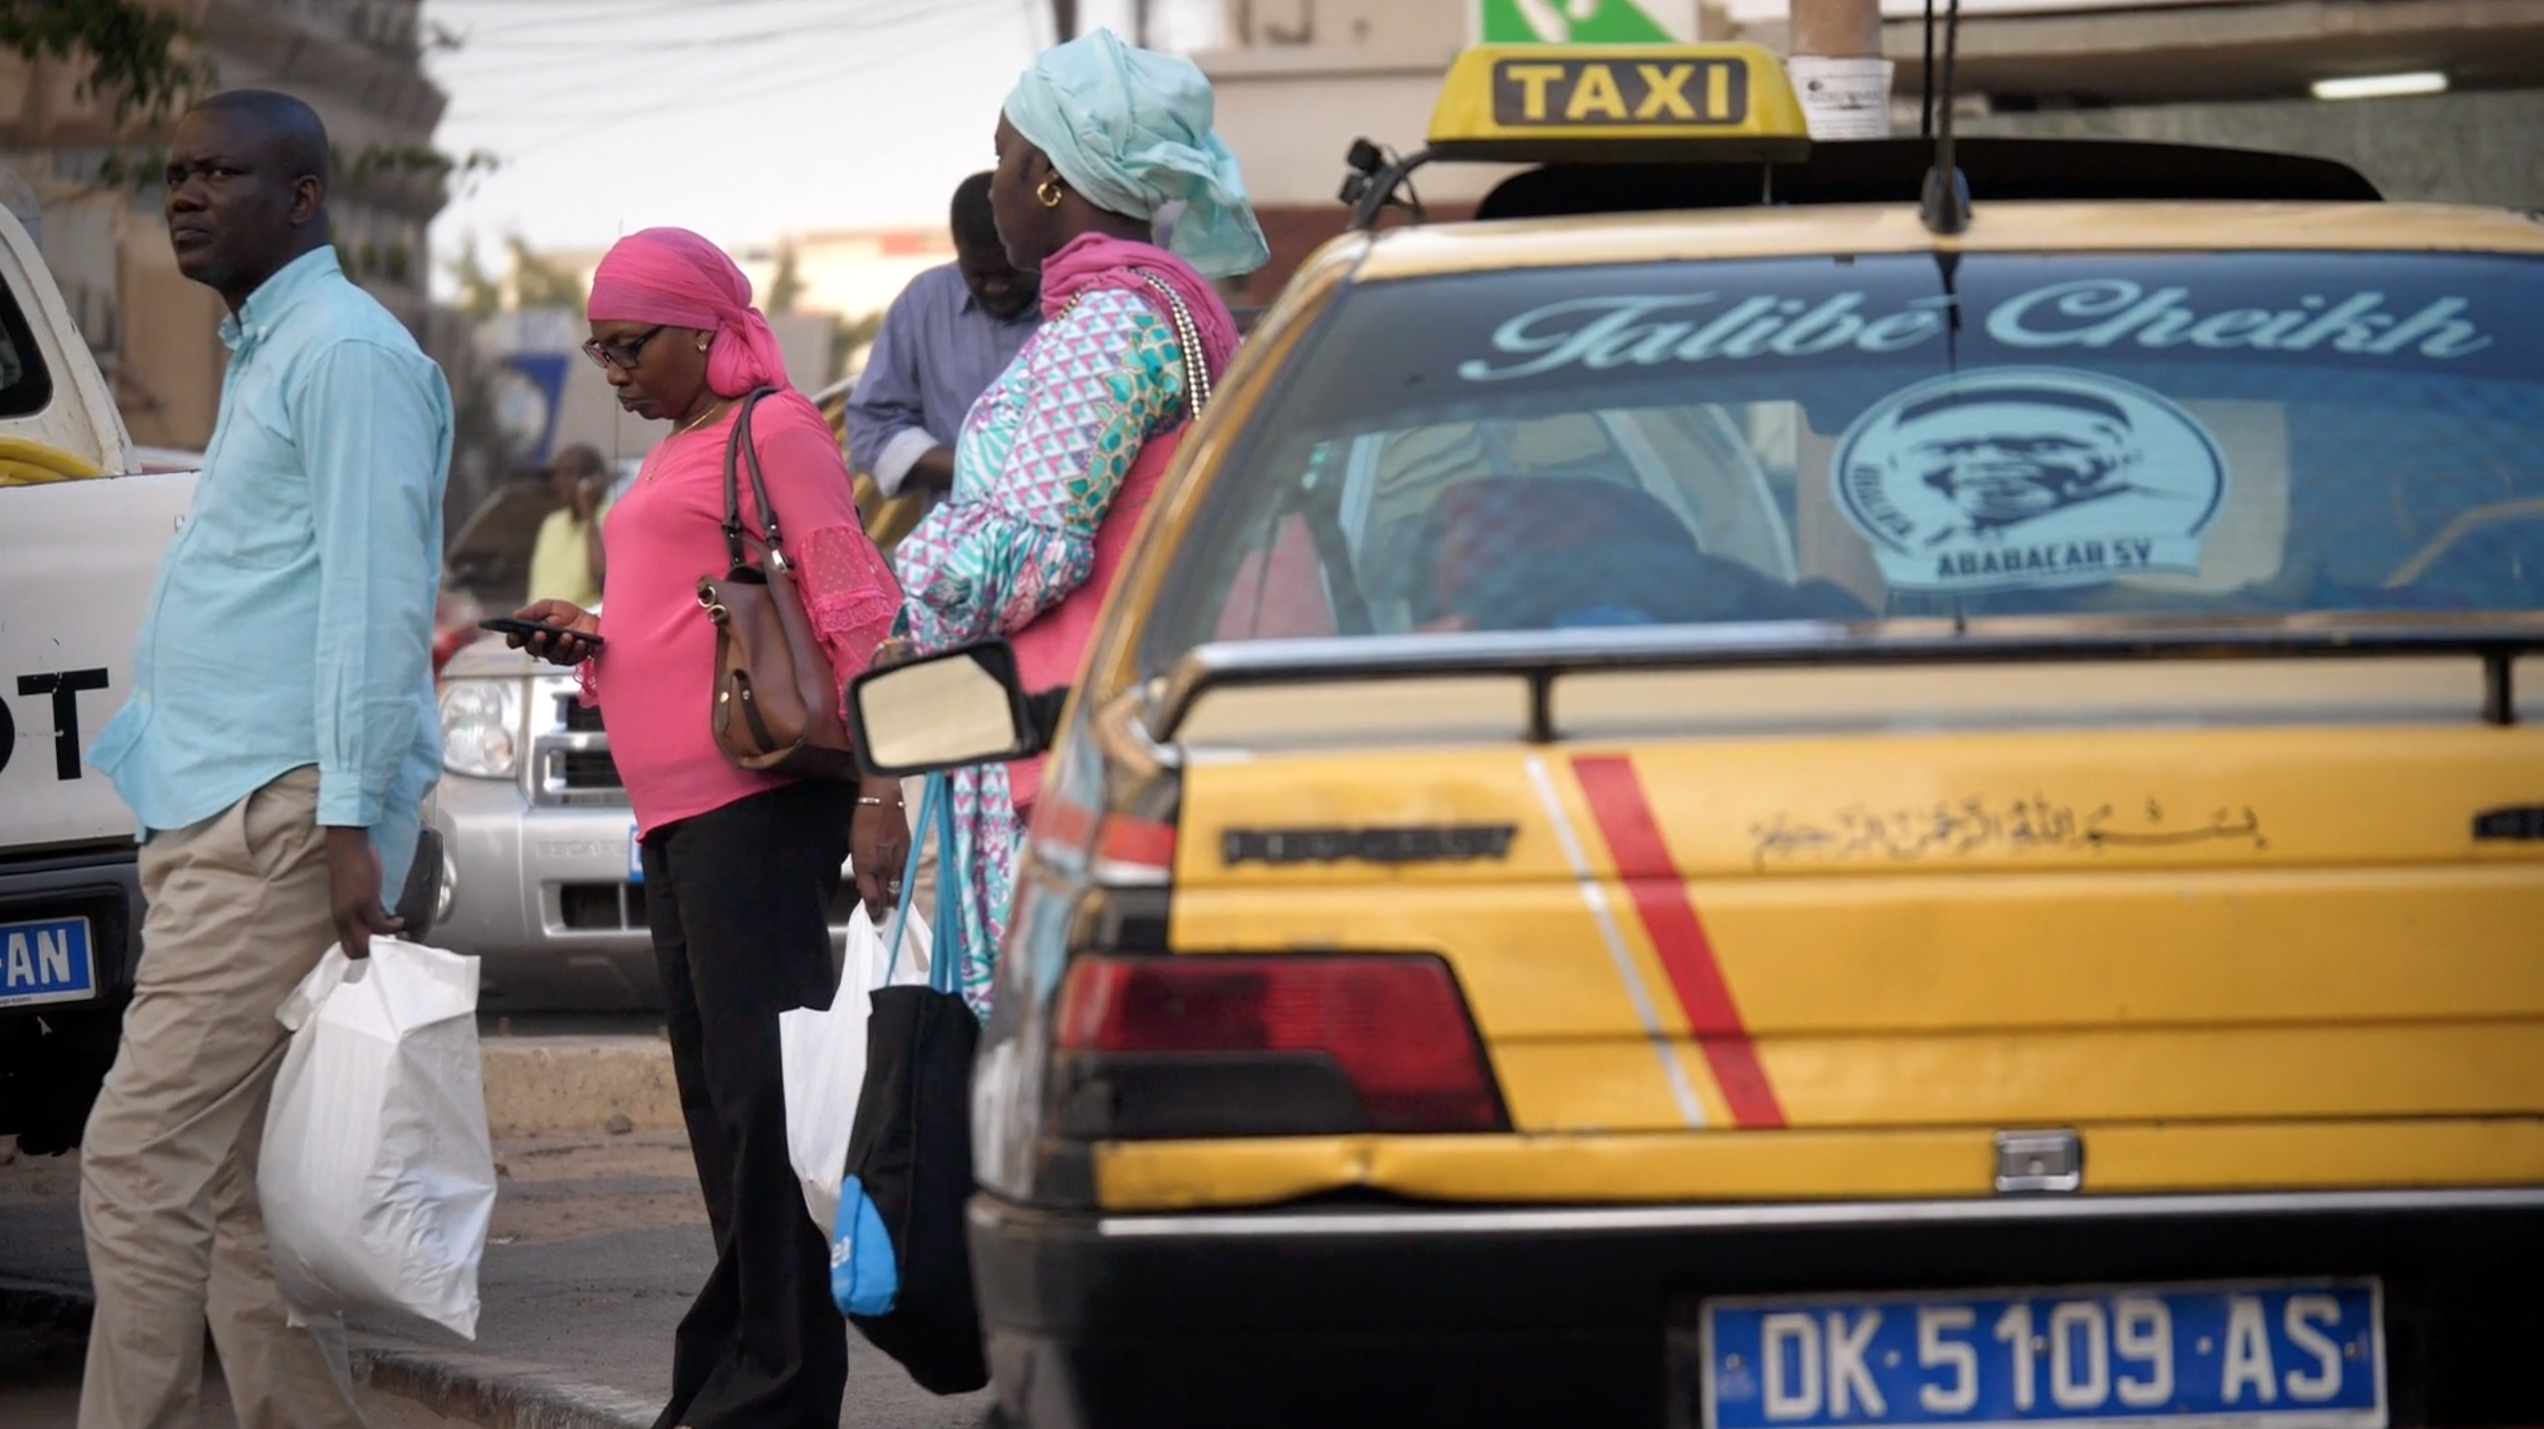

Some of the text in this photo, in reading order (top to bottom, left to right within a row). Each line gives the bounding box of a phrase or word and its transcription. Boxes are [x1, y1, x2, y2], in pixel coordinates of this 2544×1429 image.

[1506, 64, 1729, 120] TAXI
[1457, 279, 2493, 382] Talibé Cheikh
[0, 667, 109, 781] T
[1762, 1294, 2343, 1421] DK 5109 AS
